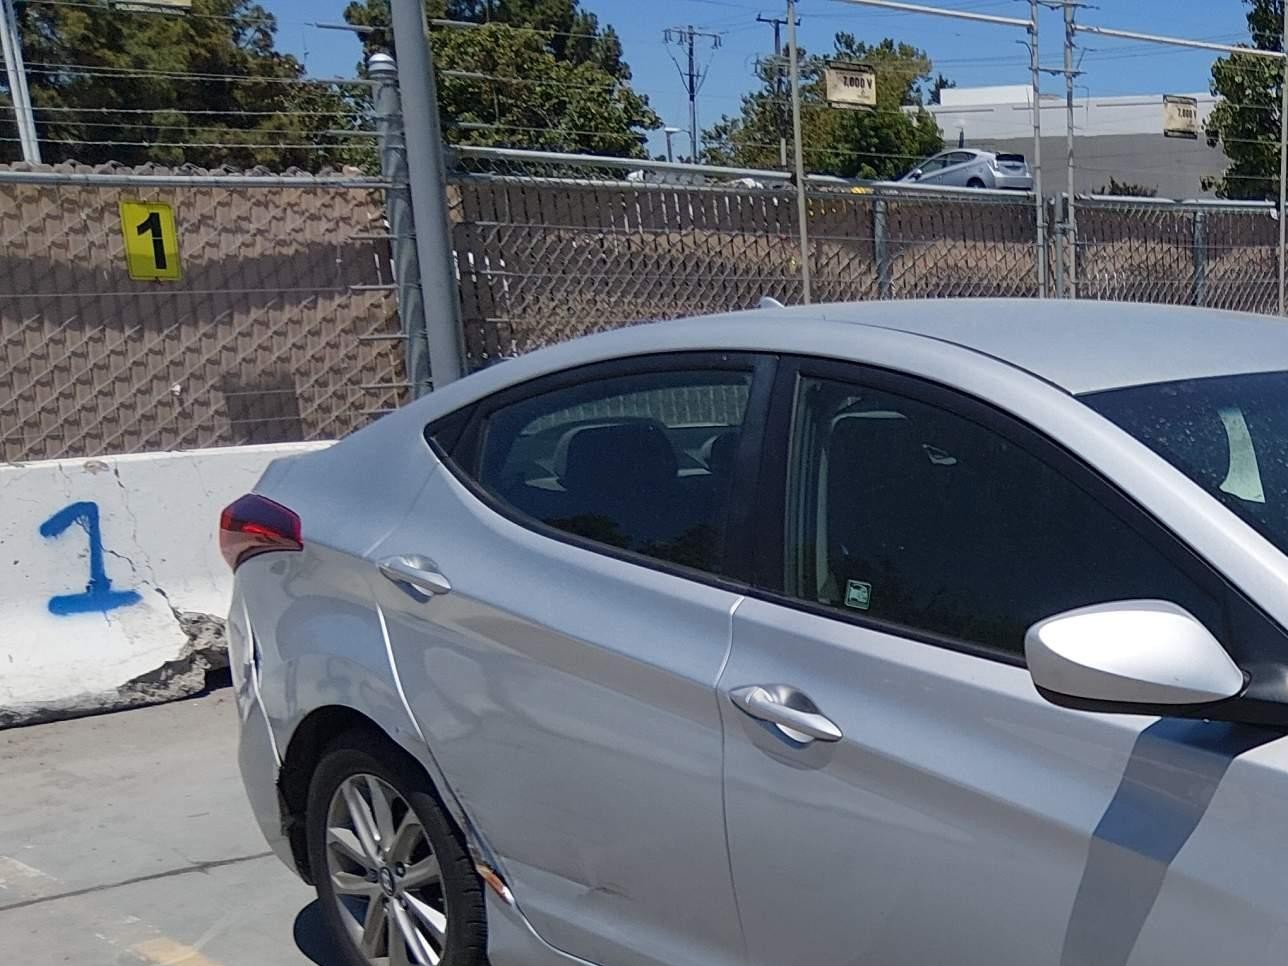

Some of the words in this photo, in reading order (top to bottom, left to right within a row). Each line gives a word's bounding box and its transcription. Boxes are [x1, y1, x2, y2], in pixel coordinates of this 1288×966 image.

[843, 76, 866, 89] 7,000
[866, 77, 873, 90] V
[136, 212, 167, 269] 1
[39, 501, 144, 615] 1
